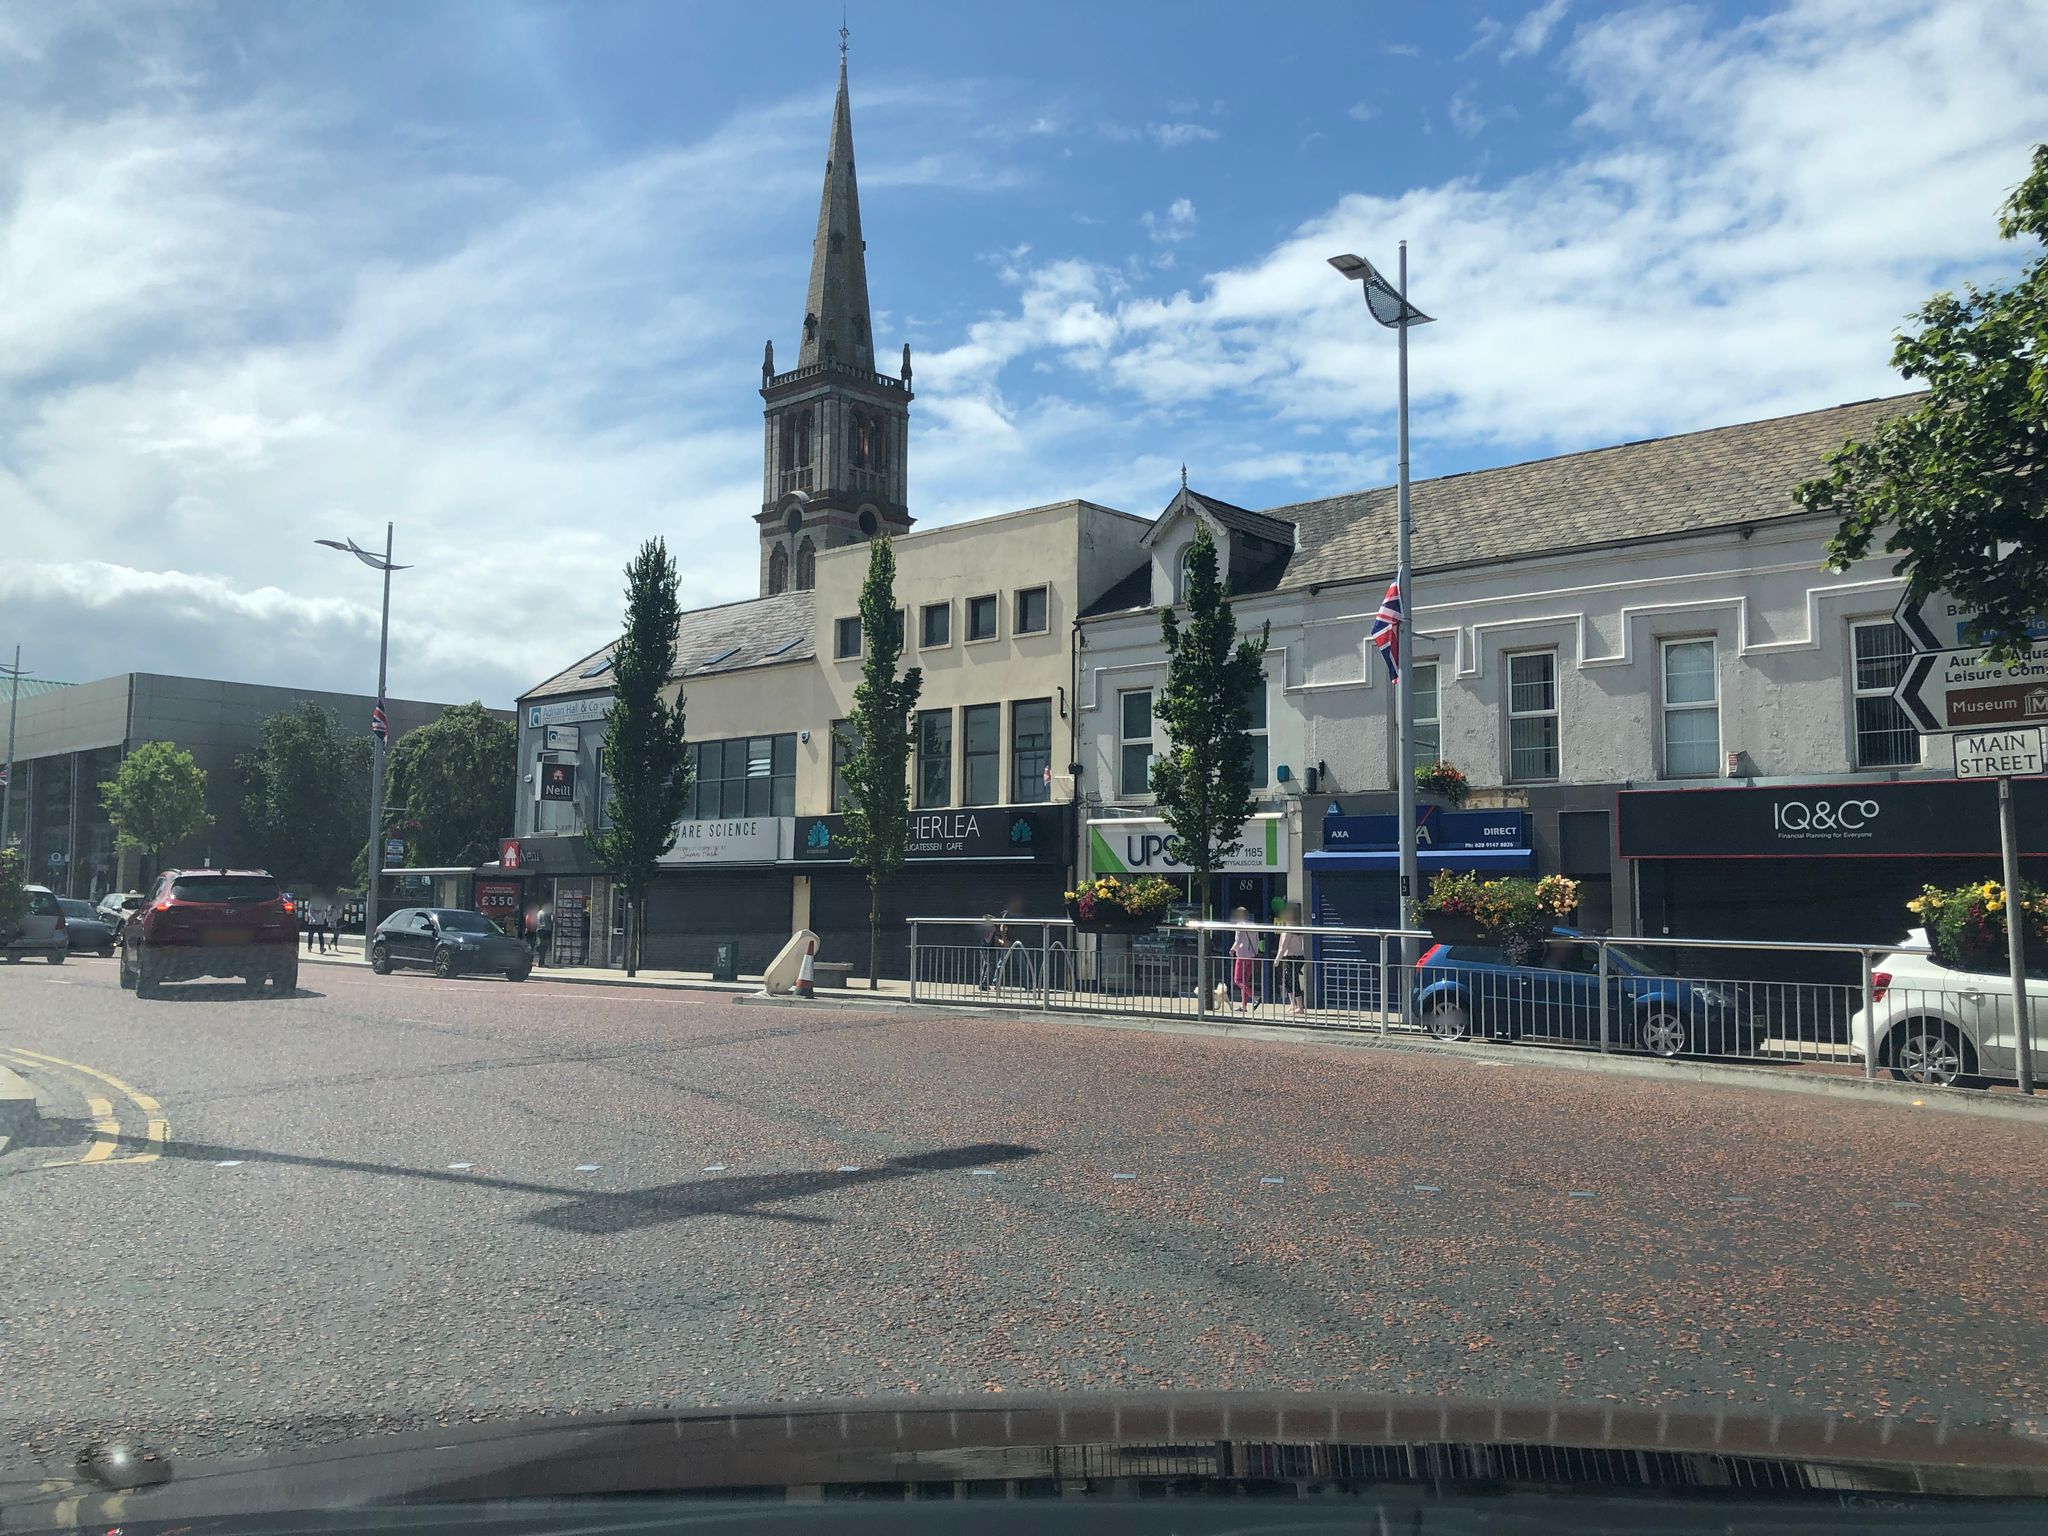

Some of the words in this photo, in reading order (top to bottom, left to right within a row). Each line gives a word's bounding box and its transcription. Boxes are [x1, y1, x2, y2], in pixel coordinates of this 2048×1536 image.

[1945, 669, 2002, 683] Leisure
[2008, 664, 2048, 677] Com
[580, 701, 587, 713] &
[588, 702, 599, 711] Co
[1953, 699, 2017, 713] Museum
[1969, 734, 2025, 753] MAIN
[1960, 754, 2037, 774] STREET
[545, 784, 571, 796] Neill
[709, 822, 757, 838] SCIENCE
[898, 814, 980, 839] HERLEA
[1331, 830, 1349, 838] AXA
[1483, 826, 1517, 836] DIRECT
[946, 842, 963, 851] CAFE
[1244, 847, 1263, 858] 1185
[1239, 879, 1254, 891] 88
[481, 896, 514, 906] £350
